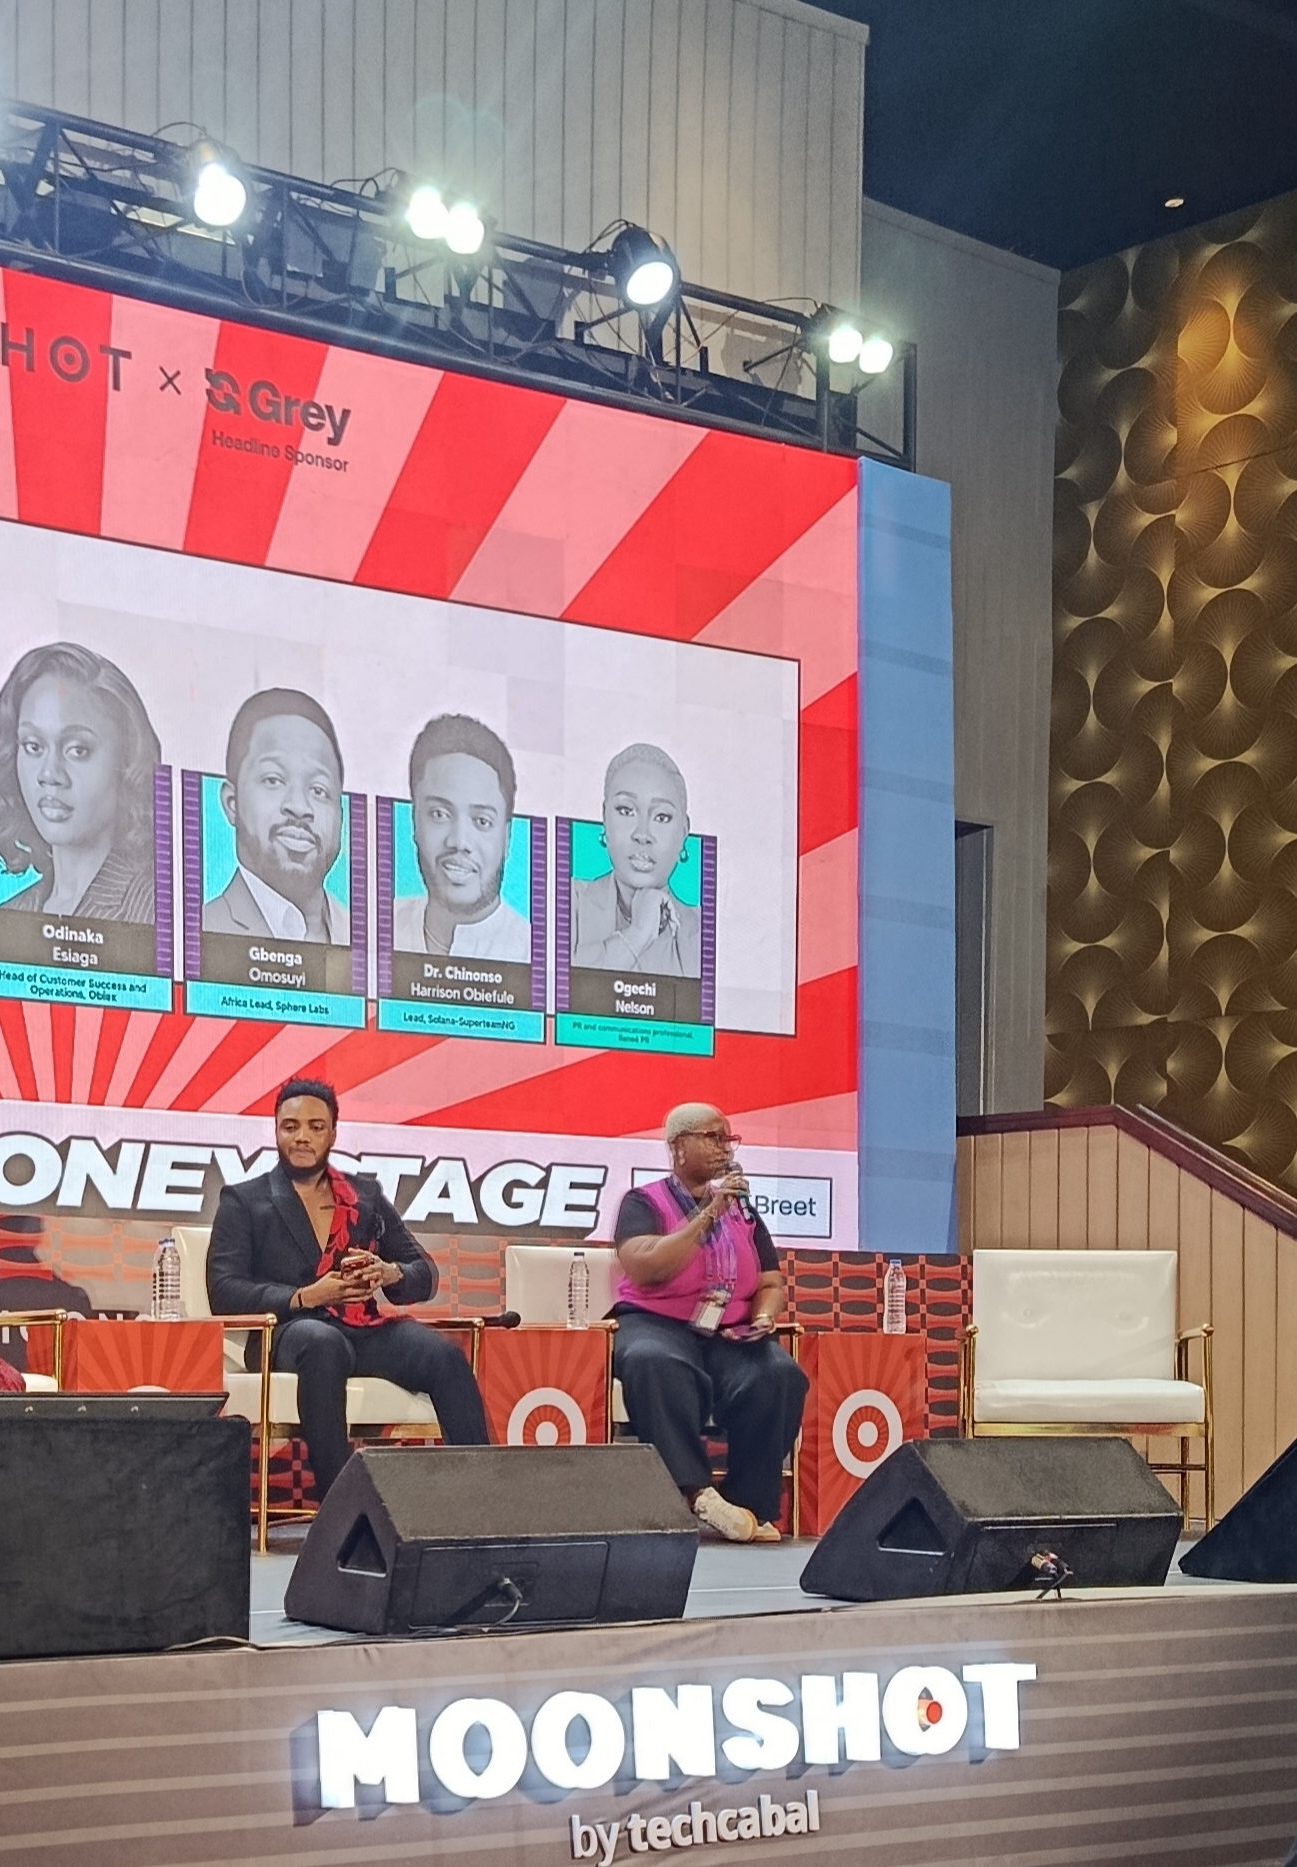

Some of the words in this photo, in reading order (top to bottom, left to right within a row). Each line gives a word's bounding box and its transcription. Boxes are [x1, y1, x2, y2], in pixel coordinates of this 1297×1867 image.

[249, 380, 351, 446] Grey
[212, 430, 280, 459] Headline
[285, 444, 349, 473] Sponsor
[42, 924, 104, 944] Odinaka
[53, 947, 98, 967] Esiaga
[249, 946, 303, 967] Gbenga
[27, 972, 37, 983] of
[39, 974, 86, 988] Customer
[249, 967, 306, 989] Omosuyi
[423, 963, 442, 979] Dr.
[445, 966, 503, 984] Chinonso
[411, 982, 461, 1000] Harrison
[614, 980, 656, 997] Ogechi
[221, 996, 248, 1008] Africa
[249, 998, 274, 1011] Lead,
[276, 1002, 306, 1014] Sphere
[308, 1003, 329, 1015] Labs
[615, 1000, 655, 1016] Nelson
[403, 1012, 426, 1024] Lead,
[755, 1195, 816, 1216] Breet
[317, 1663, 1037, 1808] MOONSHOT
[571, 1814, 621, 1867] by
[627, 1790, 820, 1852] techcabal
